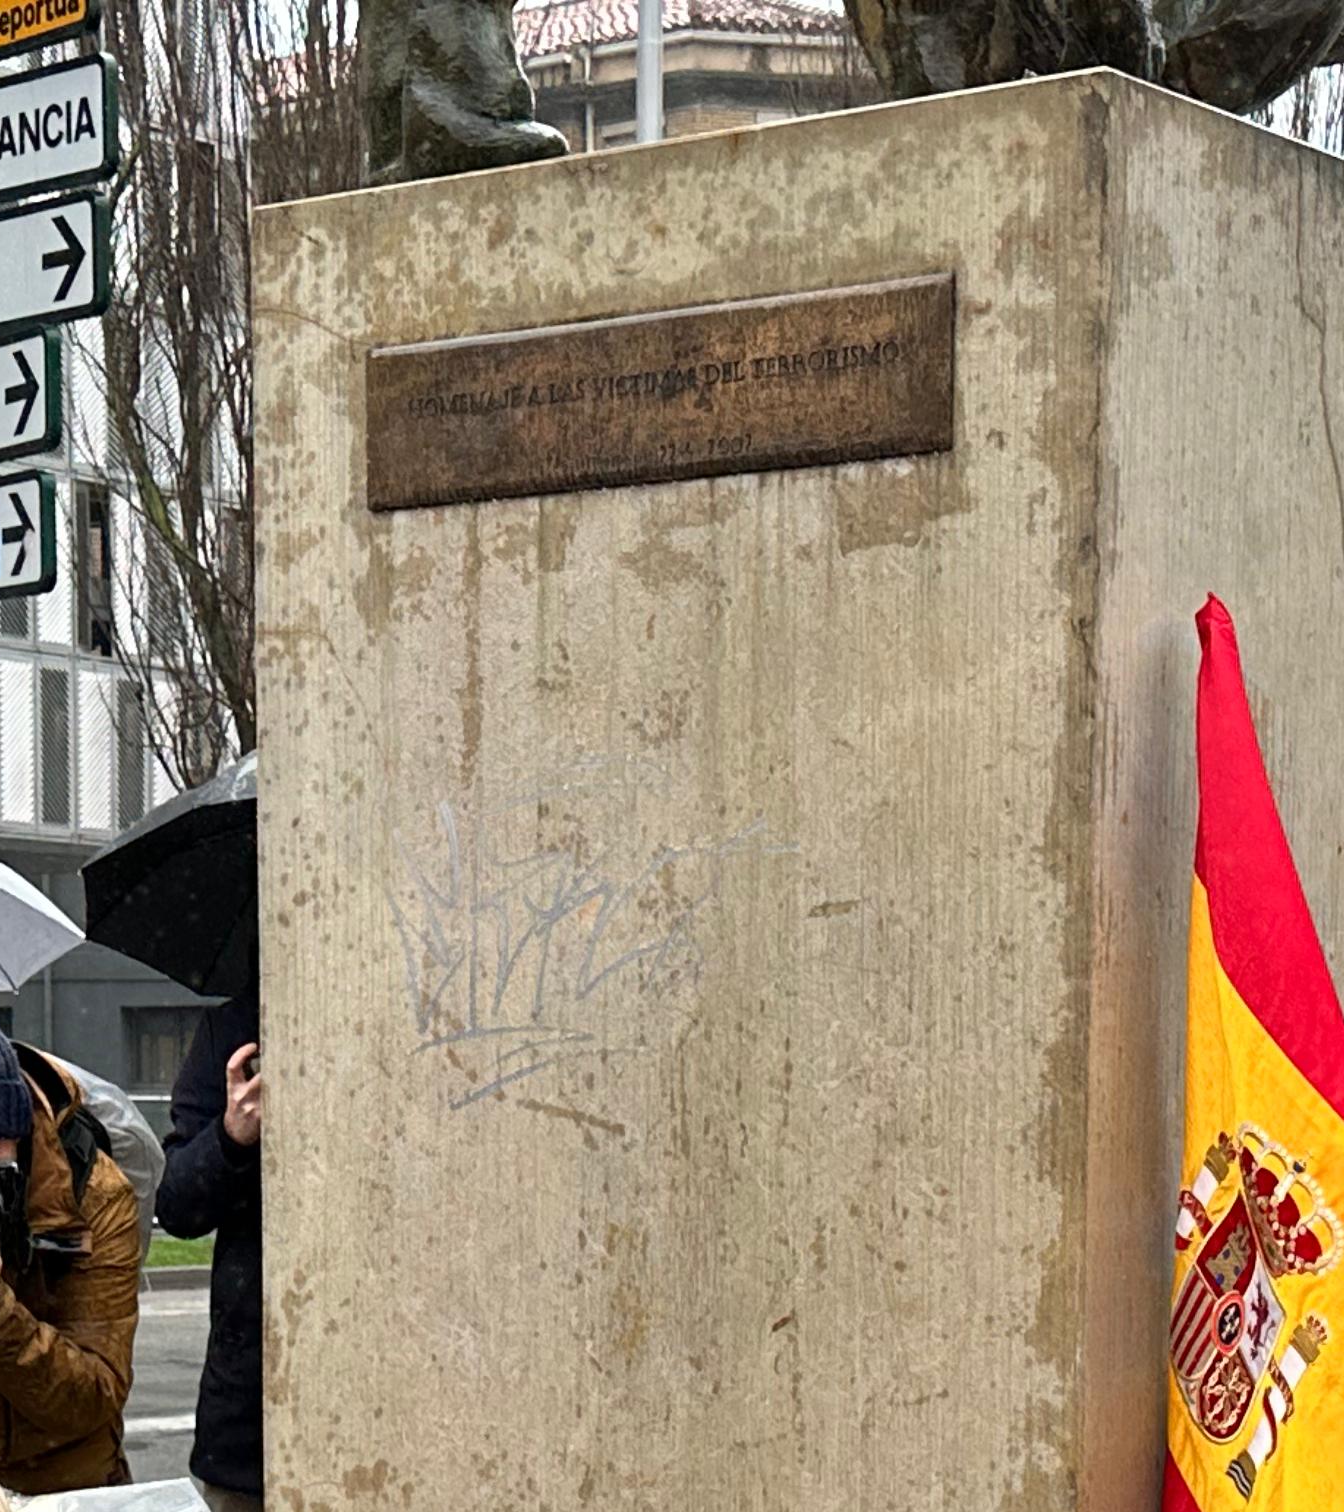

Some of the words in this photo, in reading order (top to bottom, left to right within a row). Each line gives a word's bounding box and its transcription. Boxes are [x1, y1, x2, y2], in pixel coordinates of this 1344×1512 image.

[408, 386, 523, 417] HOMENAJE
[527, 387, 543, 407] A
[548, 379, 587, 404] LAS
[703, 360, 746, 386] DEL
[750, 341, 900, 379] TERRORISMO
